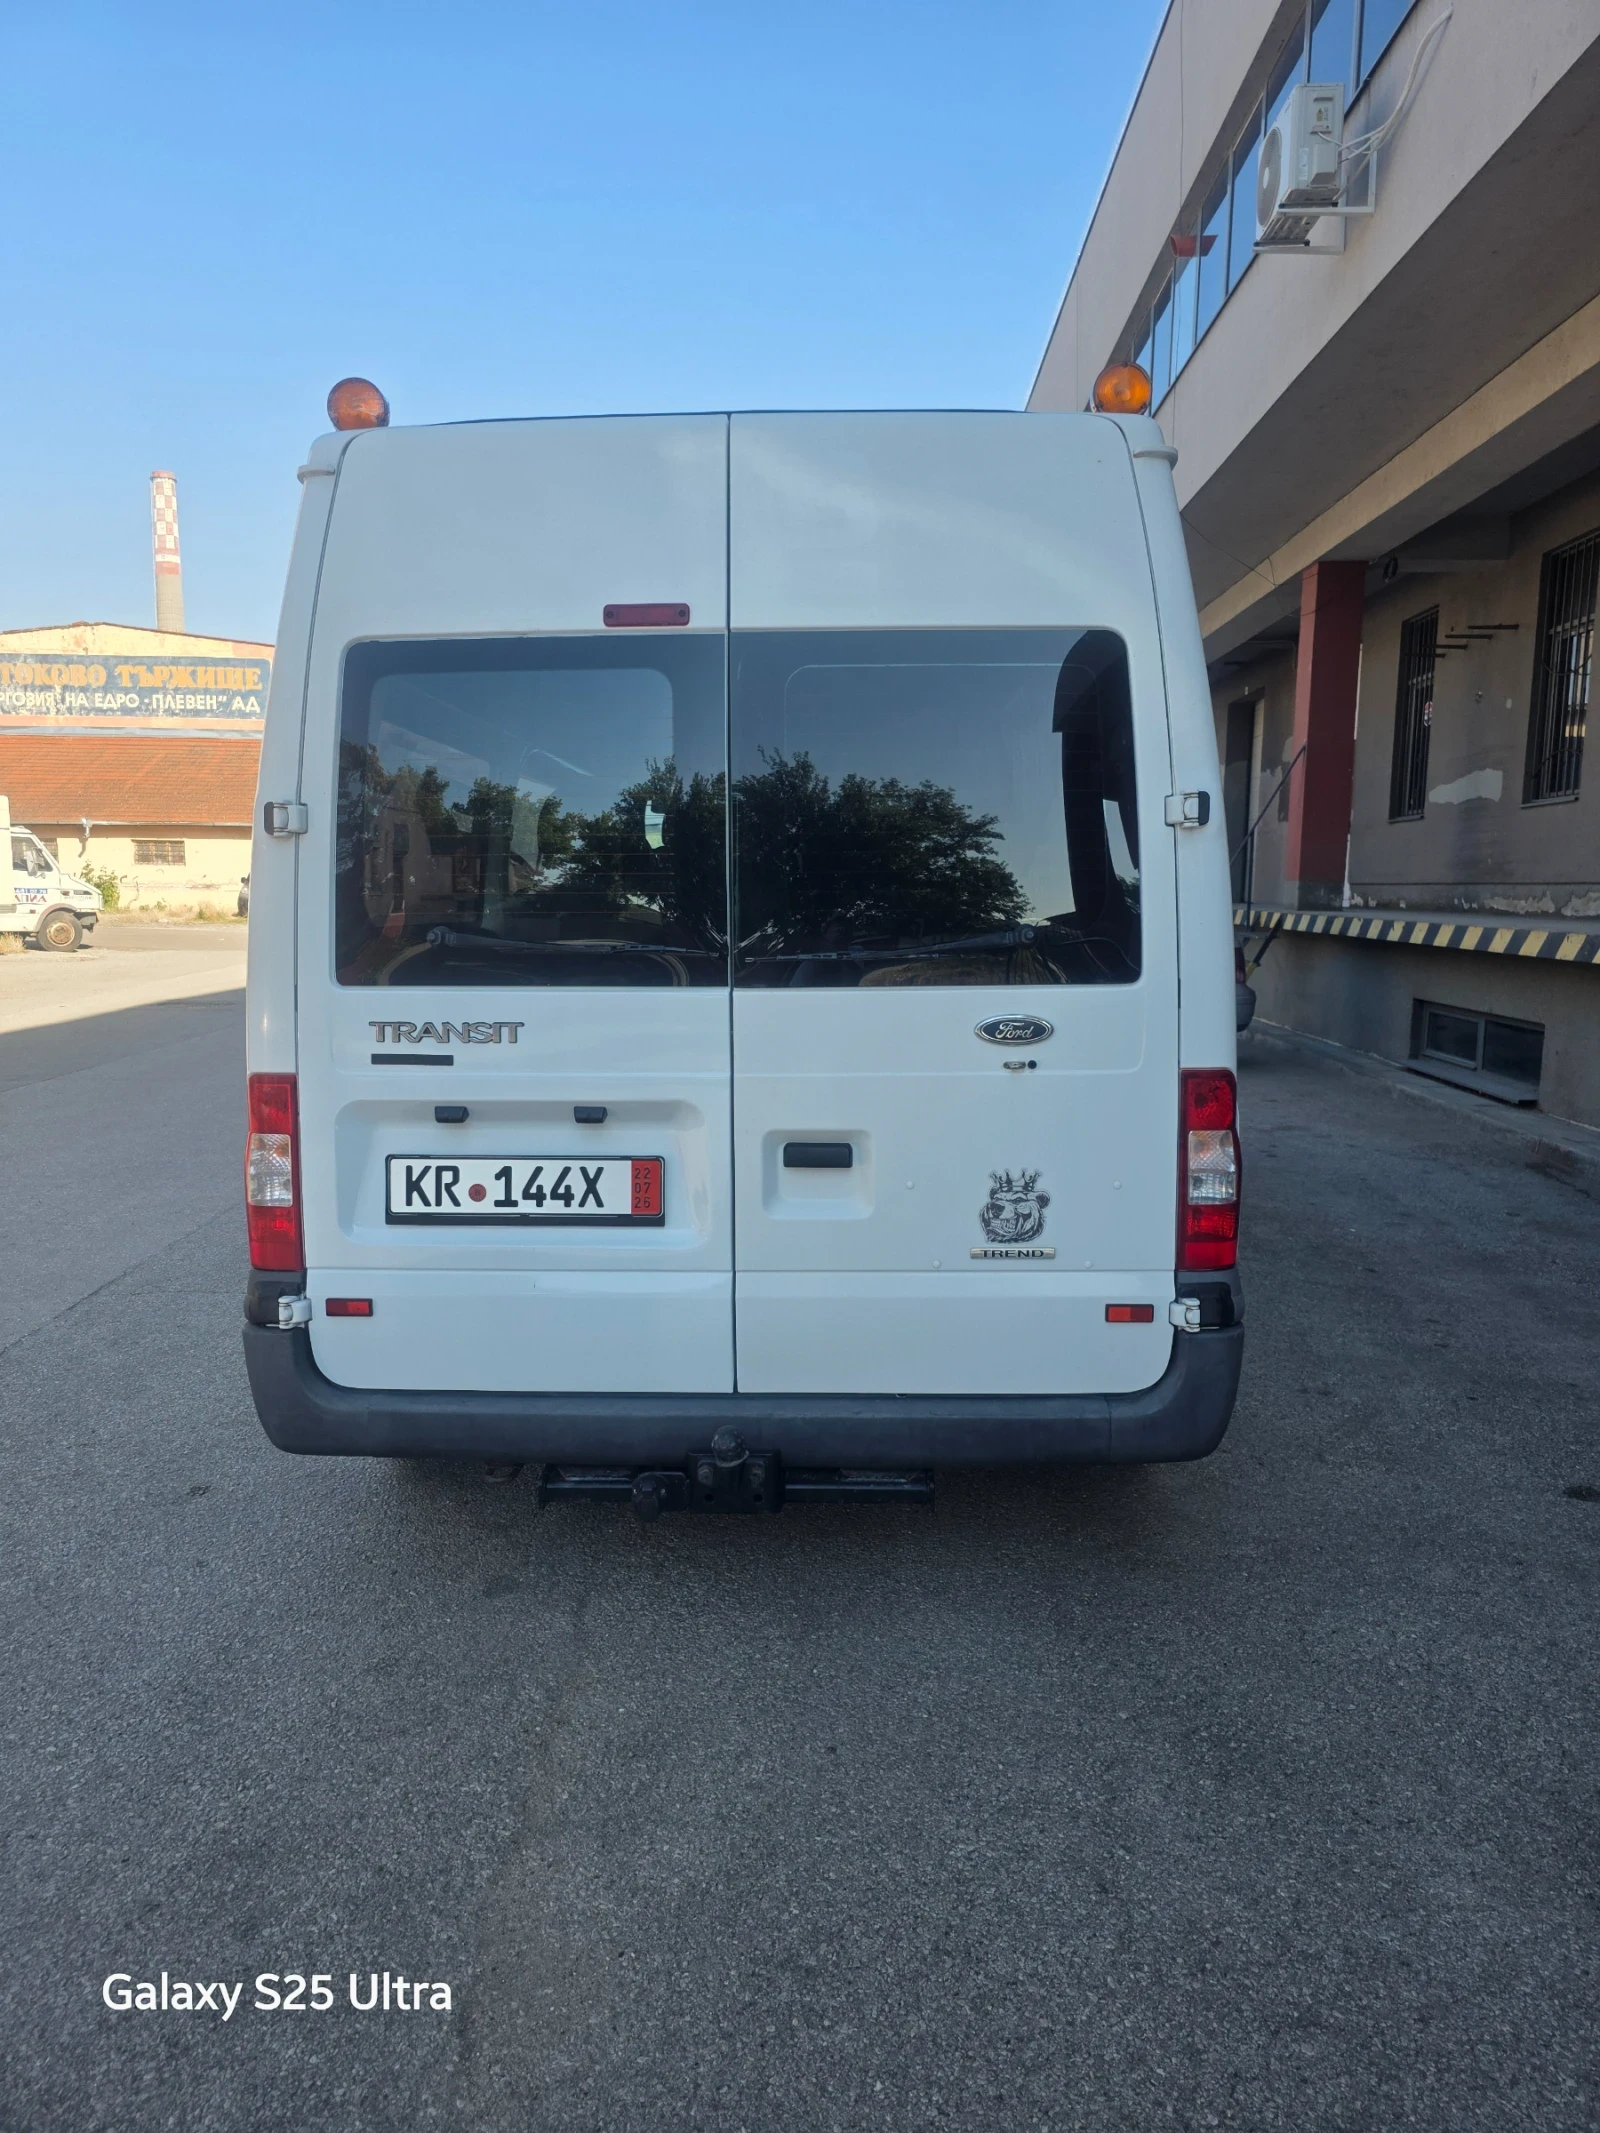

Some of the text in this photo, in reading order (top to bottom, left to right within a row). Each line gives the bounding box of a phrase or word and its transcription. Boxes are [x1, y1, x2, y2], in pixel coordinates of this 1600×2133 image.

[115, 665, 262, 691] ТЪРЖИЩЕ
[65, 692, 90, 708] НА
[94, 692, 140, 710] ЕДРО
[231, 695, 261, 713] АД
[368, 1021, 525, 1044] TRANSIT
[995, 1021, 1034, 1039] Ford
[634, 1167, 651, 1179] 22
[405, 1165, 461, 1207] KR
[493, 1165, 605, 1208] 144X
[634, 1182, 651, 1194] 07
[634, 1196, 651, 1209] 26
[980, 1249, 1044, 1258] TREND
